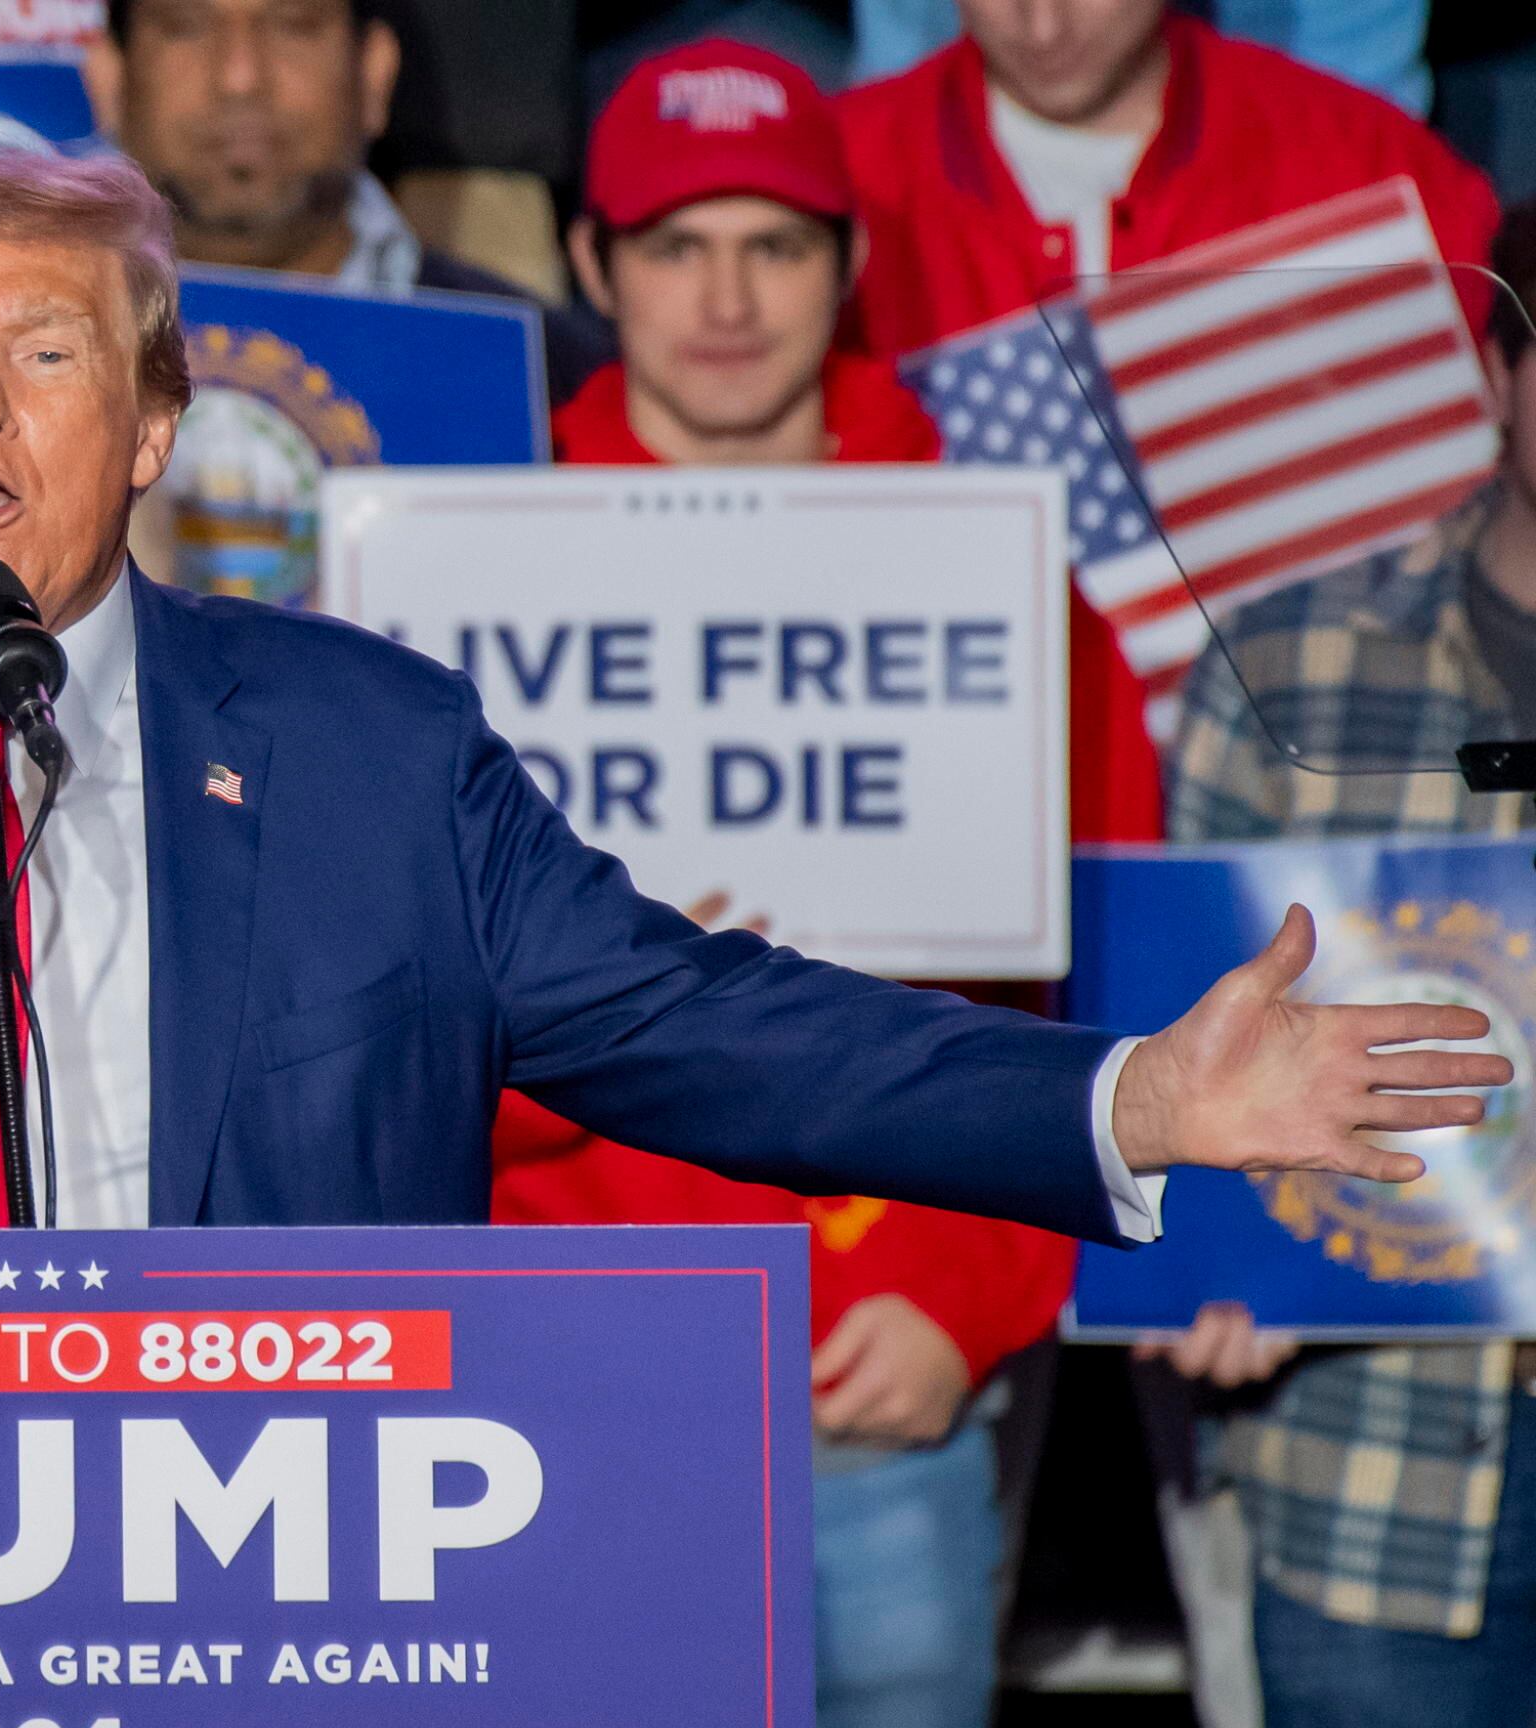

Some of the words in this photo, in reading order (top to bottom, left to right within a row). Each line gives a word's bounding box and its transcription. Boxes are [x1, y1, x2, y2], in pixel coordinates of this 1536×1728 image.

[386, 620, 654, 706] IVE
[702, 621, 1009, 704] FREE
[710, 746, 906, 827] DIE
[0, 1322, 109, 1383] TO
[138, 1321, 394, 1383] 88022
[39, 1643, 243, 1686] GREAT
[267, 1642, 490, 1684] AGAIN!
